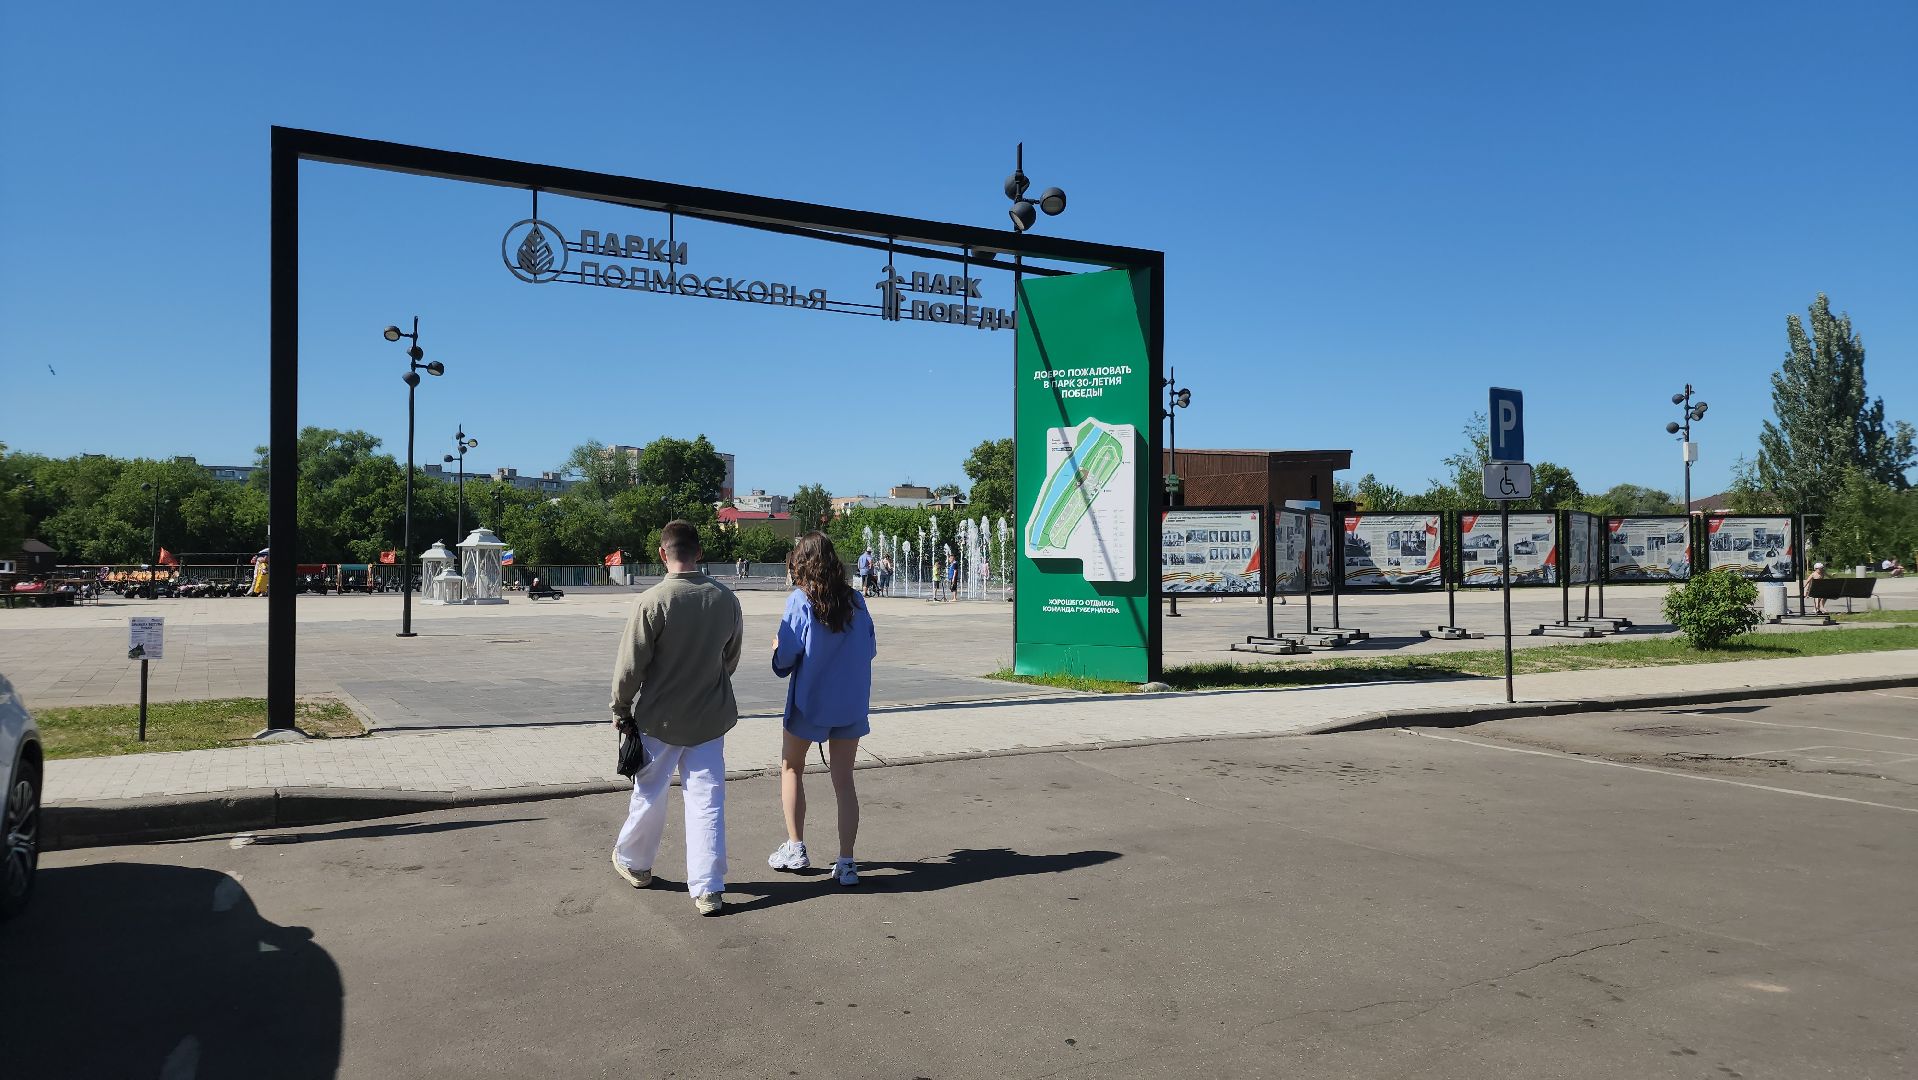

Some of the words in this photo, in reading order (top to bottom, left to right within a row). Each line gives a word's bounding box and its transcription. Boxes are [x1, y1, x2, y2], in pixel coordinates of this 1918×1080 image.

[581, 230, 687, 265] ПАРКИ
[581, 261, 827, 310] ПОДМОСКОВЬЯ
[912, 271, 982, 298] ПАРК
[912, 300, 1018, 331] ПОБЕДЫ
[1034, 370, 1065, 380] ДОБРО
[1067, 365, 1132, 377] ПОЖАЛОВАТЬ
[1043, 380, 1049, 389] В
[1051, 379, 1075, 389] ПАРК
[1076, 376, 1122, 387] 30-ЛЕТИЯ
[1061, 388, 1103, 398] ПОБЕДЫ!
[1498, 399, 1517, 448] P
[1042, 605, 1075, 613] КОМАНДА
[1075, 606, 1120, 614] ГУБЕРНАТОРА
[1048, 598, 1084, 606] ХОРОШЕГО
